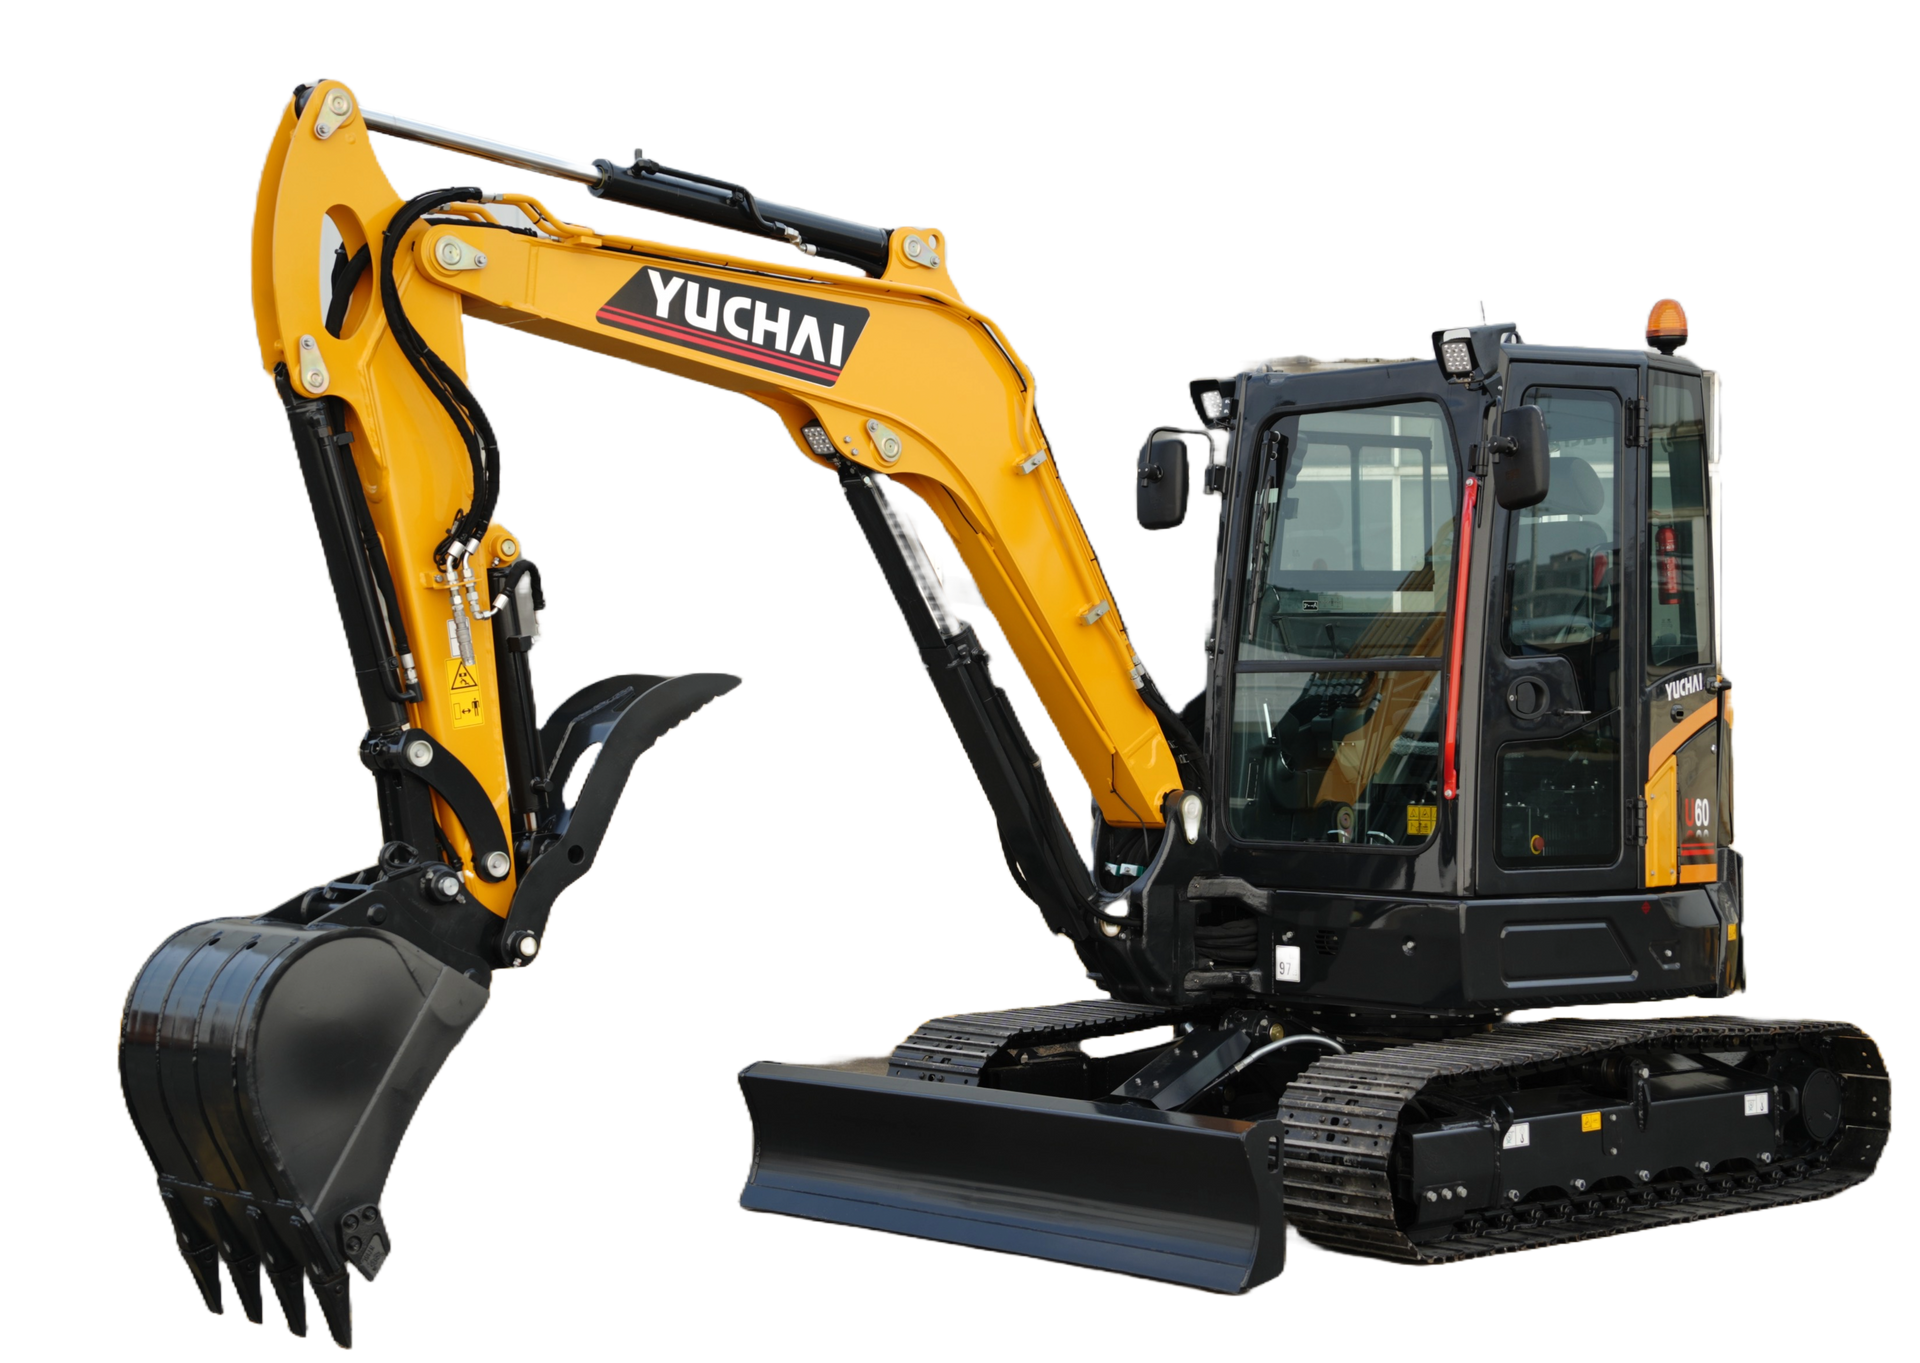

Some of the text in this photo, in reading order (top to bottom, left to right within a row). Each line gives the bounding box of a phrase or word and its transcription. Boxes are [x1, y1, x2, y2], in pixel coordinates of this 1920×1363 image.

[647, 269, 845, 367] YUCHAI
[1665, 672, 1703, 701] YUCHAI
[1684, 798, 1710, 827] U60
[1279, 961, 1291, 975] 97
